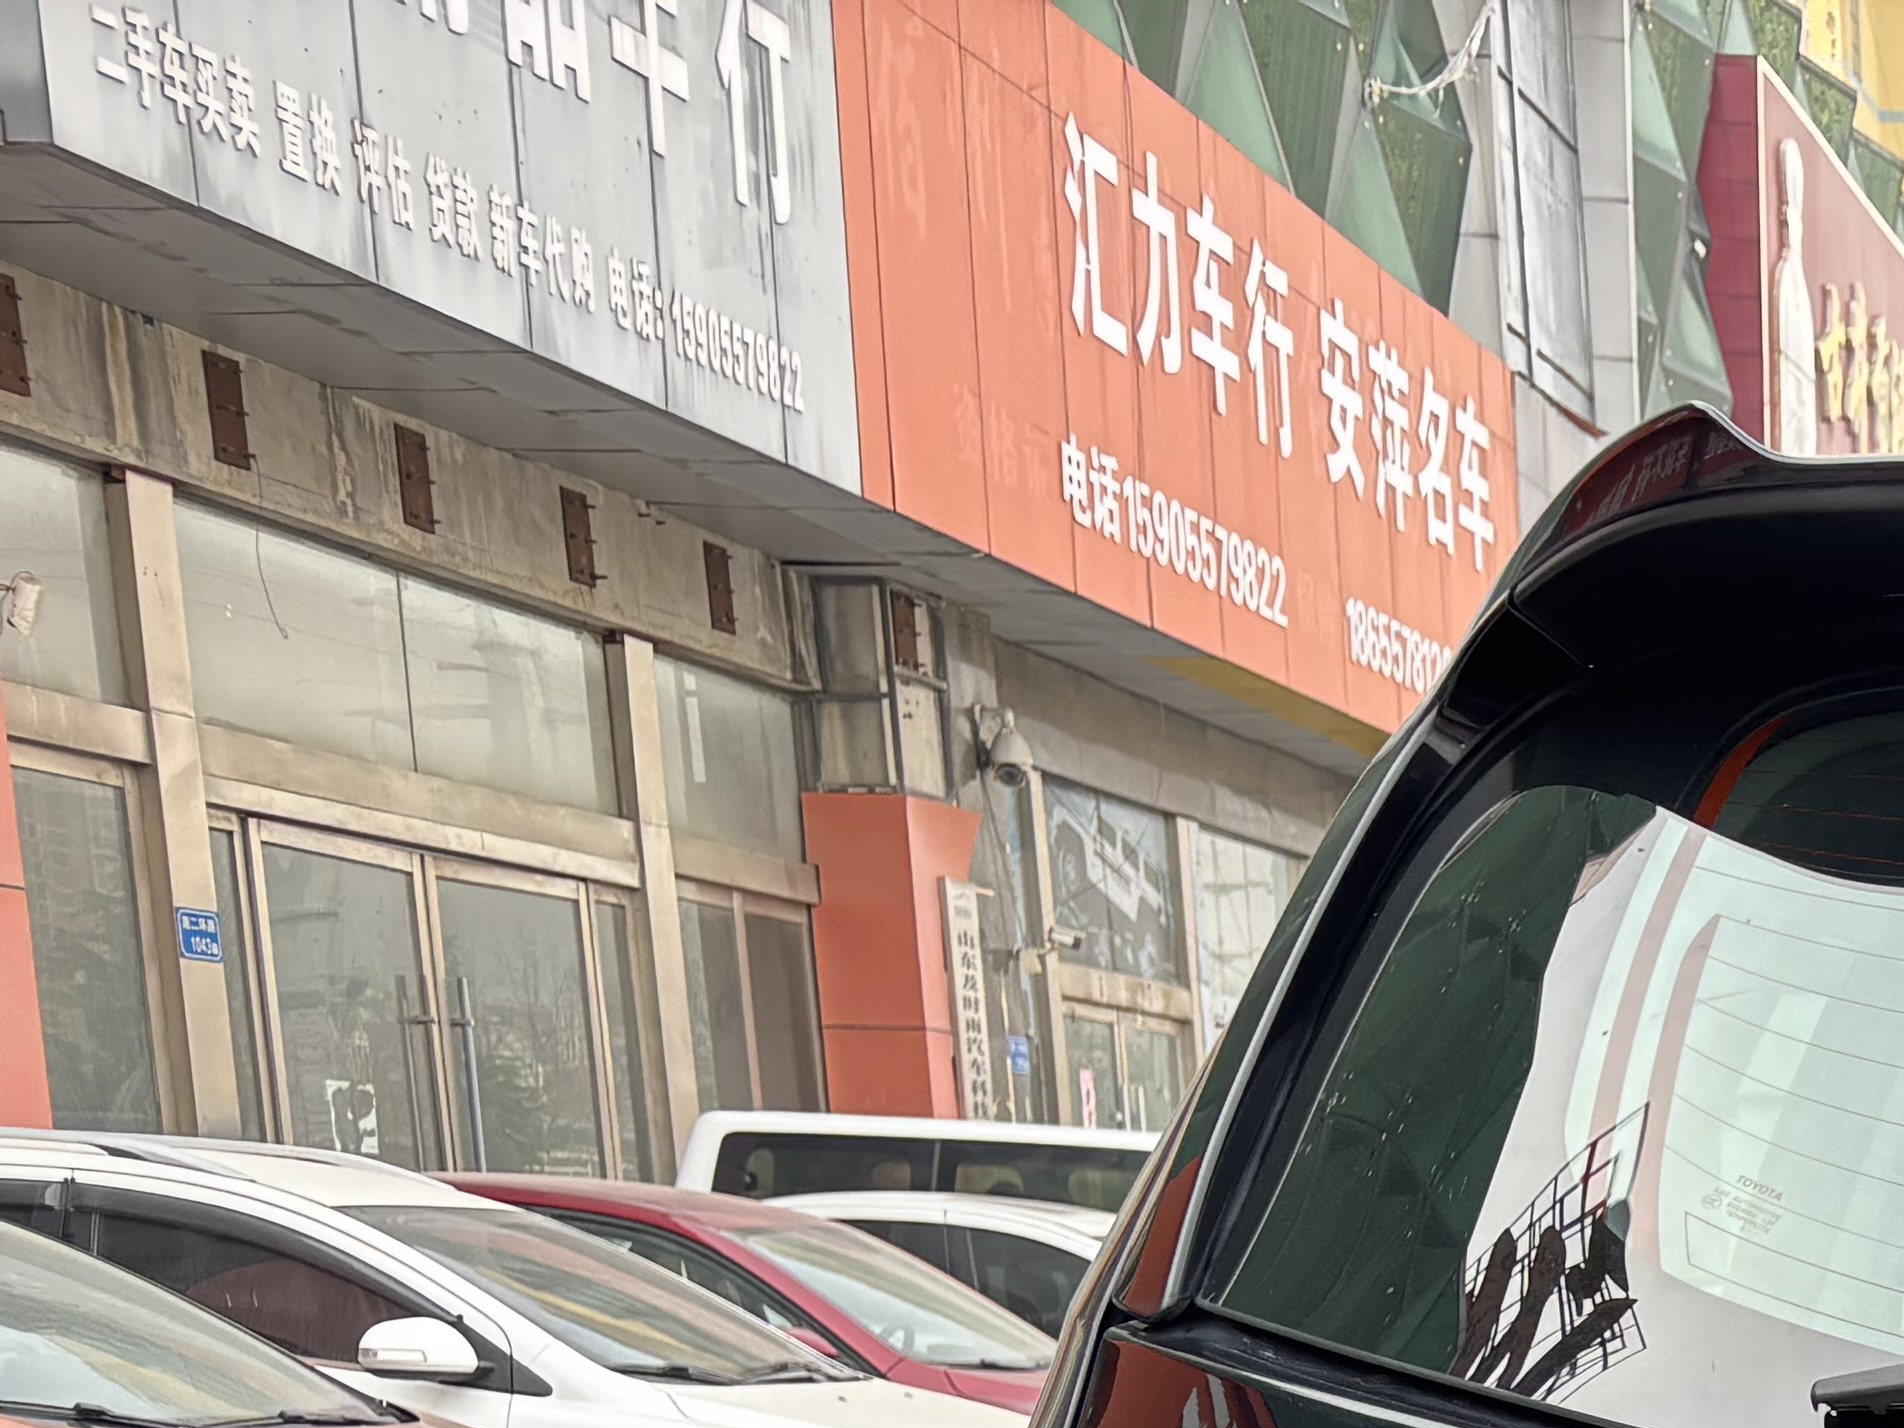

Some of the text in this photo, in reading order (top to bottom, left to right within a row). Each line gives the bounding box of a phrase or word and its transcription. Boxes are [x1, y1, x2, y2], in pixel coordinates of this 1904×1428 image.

[91, 4, 259, 158] 二手车买卖
[273, 79, 342, 197] 置换
[352, 118, 415, 232] 评估
[425, 152, 482, 262] 贷款
[488, 183, 596, 314] 新车代购
[1063, 111, 1294, 459] 汇力车行
[1319, 296, 1496, 573] 安萍名车
